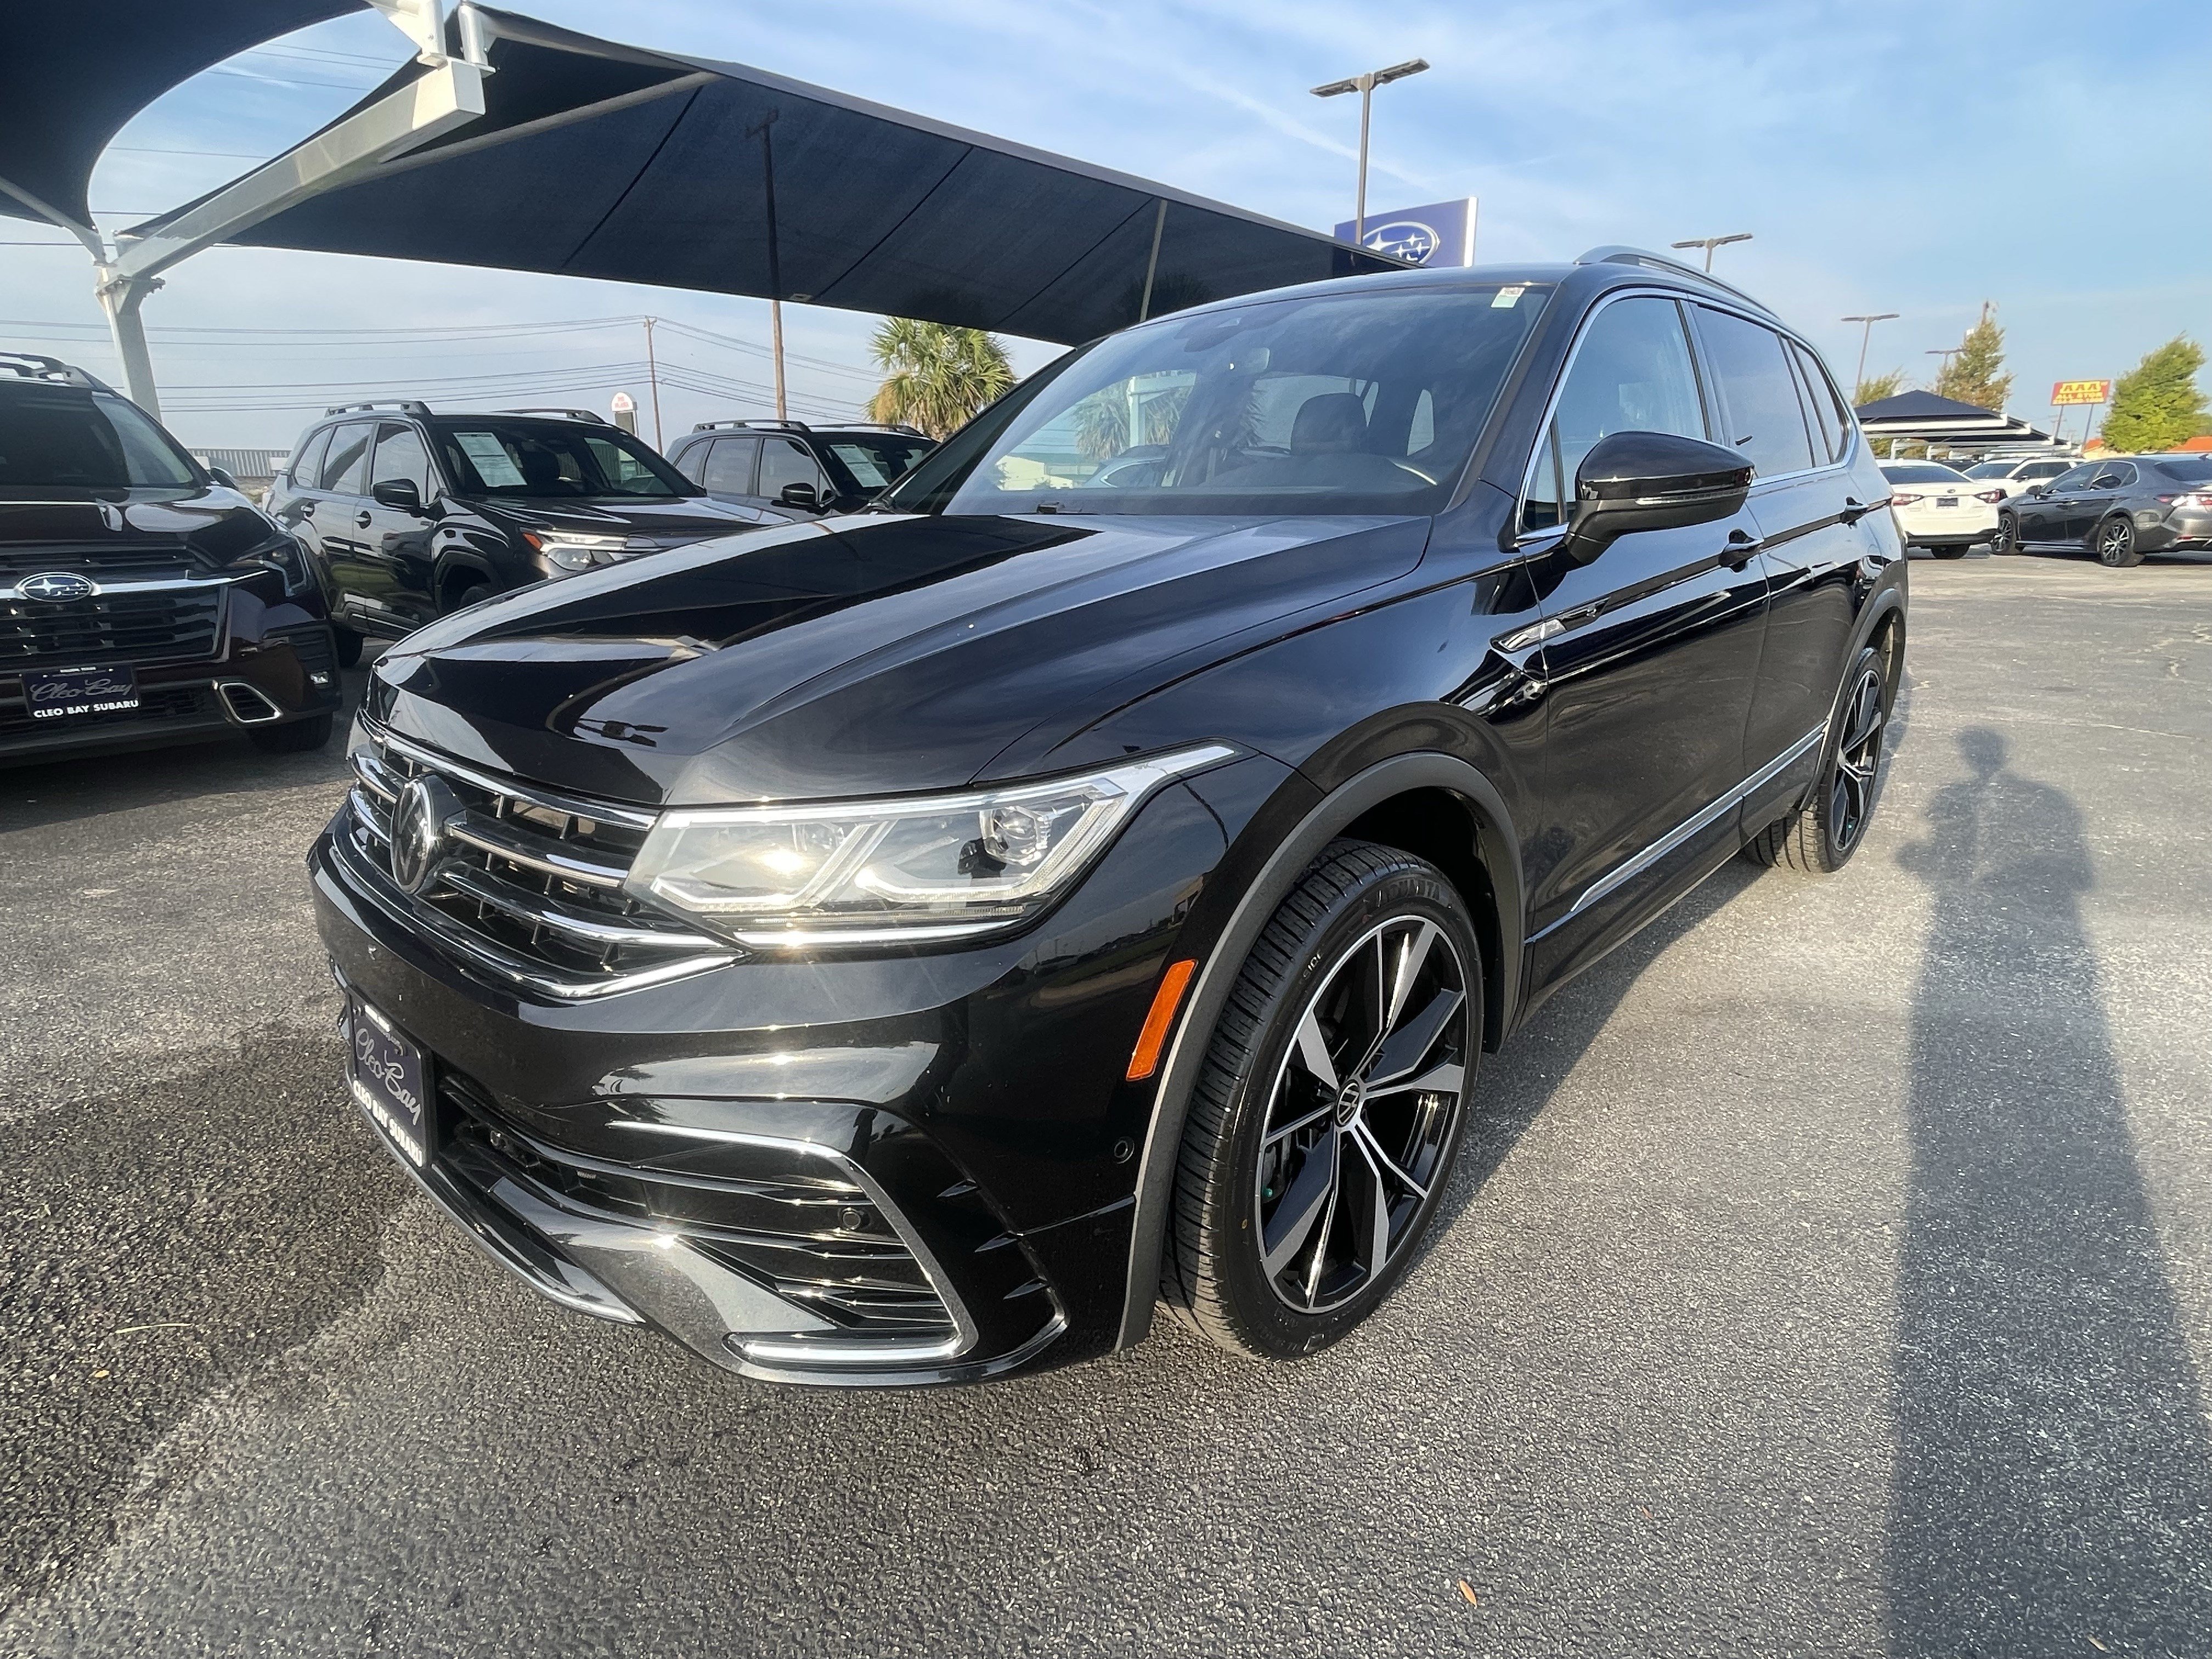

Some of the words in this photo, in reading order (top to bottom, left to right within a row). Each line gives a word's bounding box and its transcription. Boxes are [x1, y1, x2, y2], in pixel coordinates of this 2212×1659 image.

[2061, 382, 2099, 392] AAA
[30, 682, 84, 702] Cleo
[84, 678, 133, 696] Bay
[33, 708, 64, 718] CLEO
[66, 704, 90, 714] BAY
[93, 699, 139, 712] SUBARU
[354, 1020, 385, 1079] Cleo
[384, 1049, 421, 1125] Bay
[353, 1080, 373, 1110] CLEO
[372, 1099, 388, 1128] BAY
[388, 1118, 422, 1167] SUBARU
